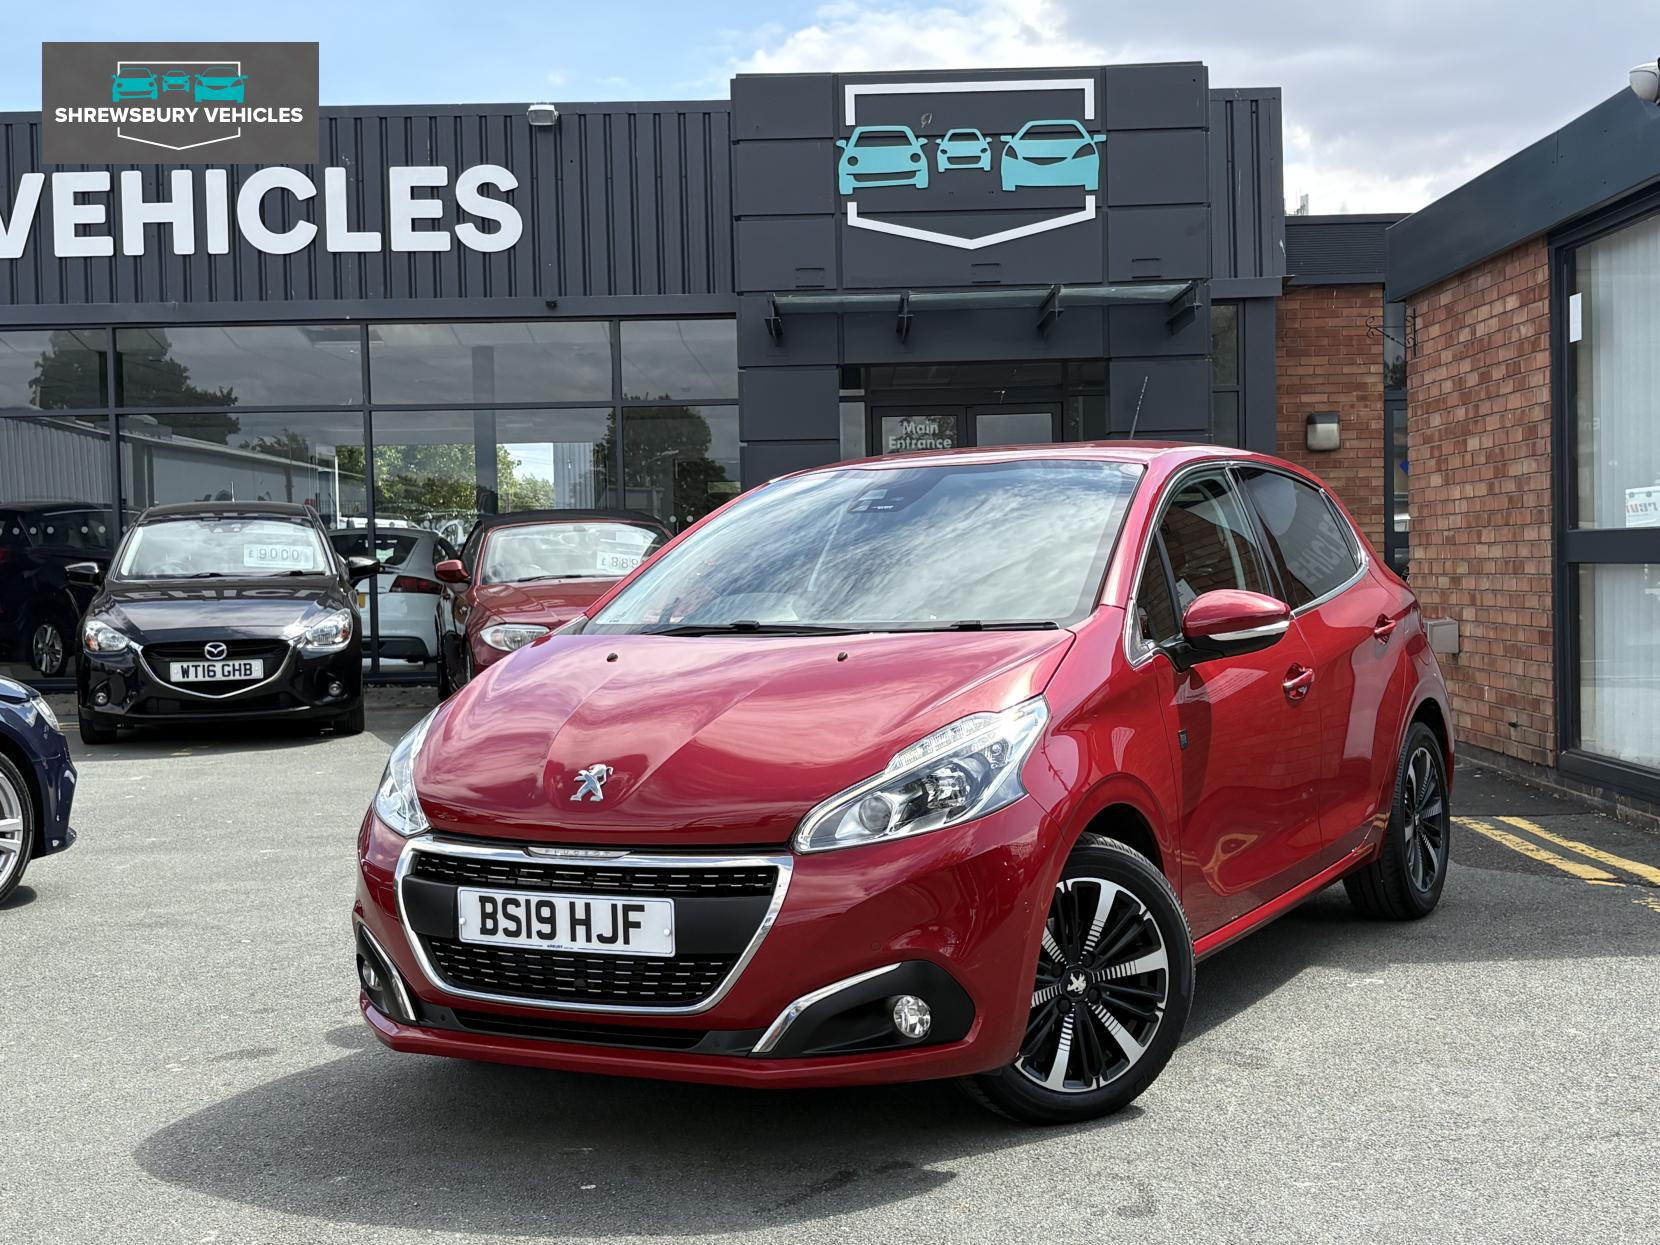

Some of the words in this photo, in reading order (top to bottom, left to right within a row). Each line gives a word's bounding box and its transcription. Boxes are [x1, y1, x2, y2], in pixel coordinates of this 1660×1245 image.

[0, 164, 524, 258] VEHICLES
[902, 420, 939, 434] Main
[889, 436, 952, 449] Entrance
[180, 664, 217, 679] WT16
[221, 662, 253, 678] GHB
[478, 895, 558, 941] BS19
[569, 901, 646, 945] HJF
